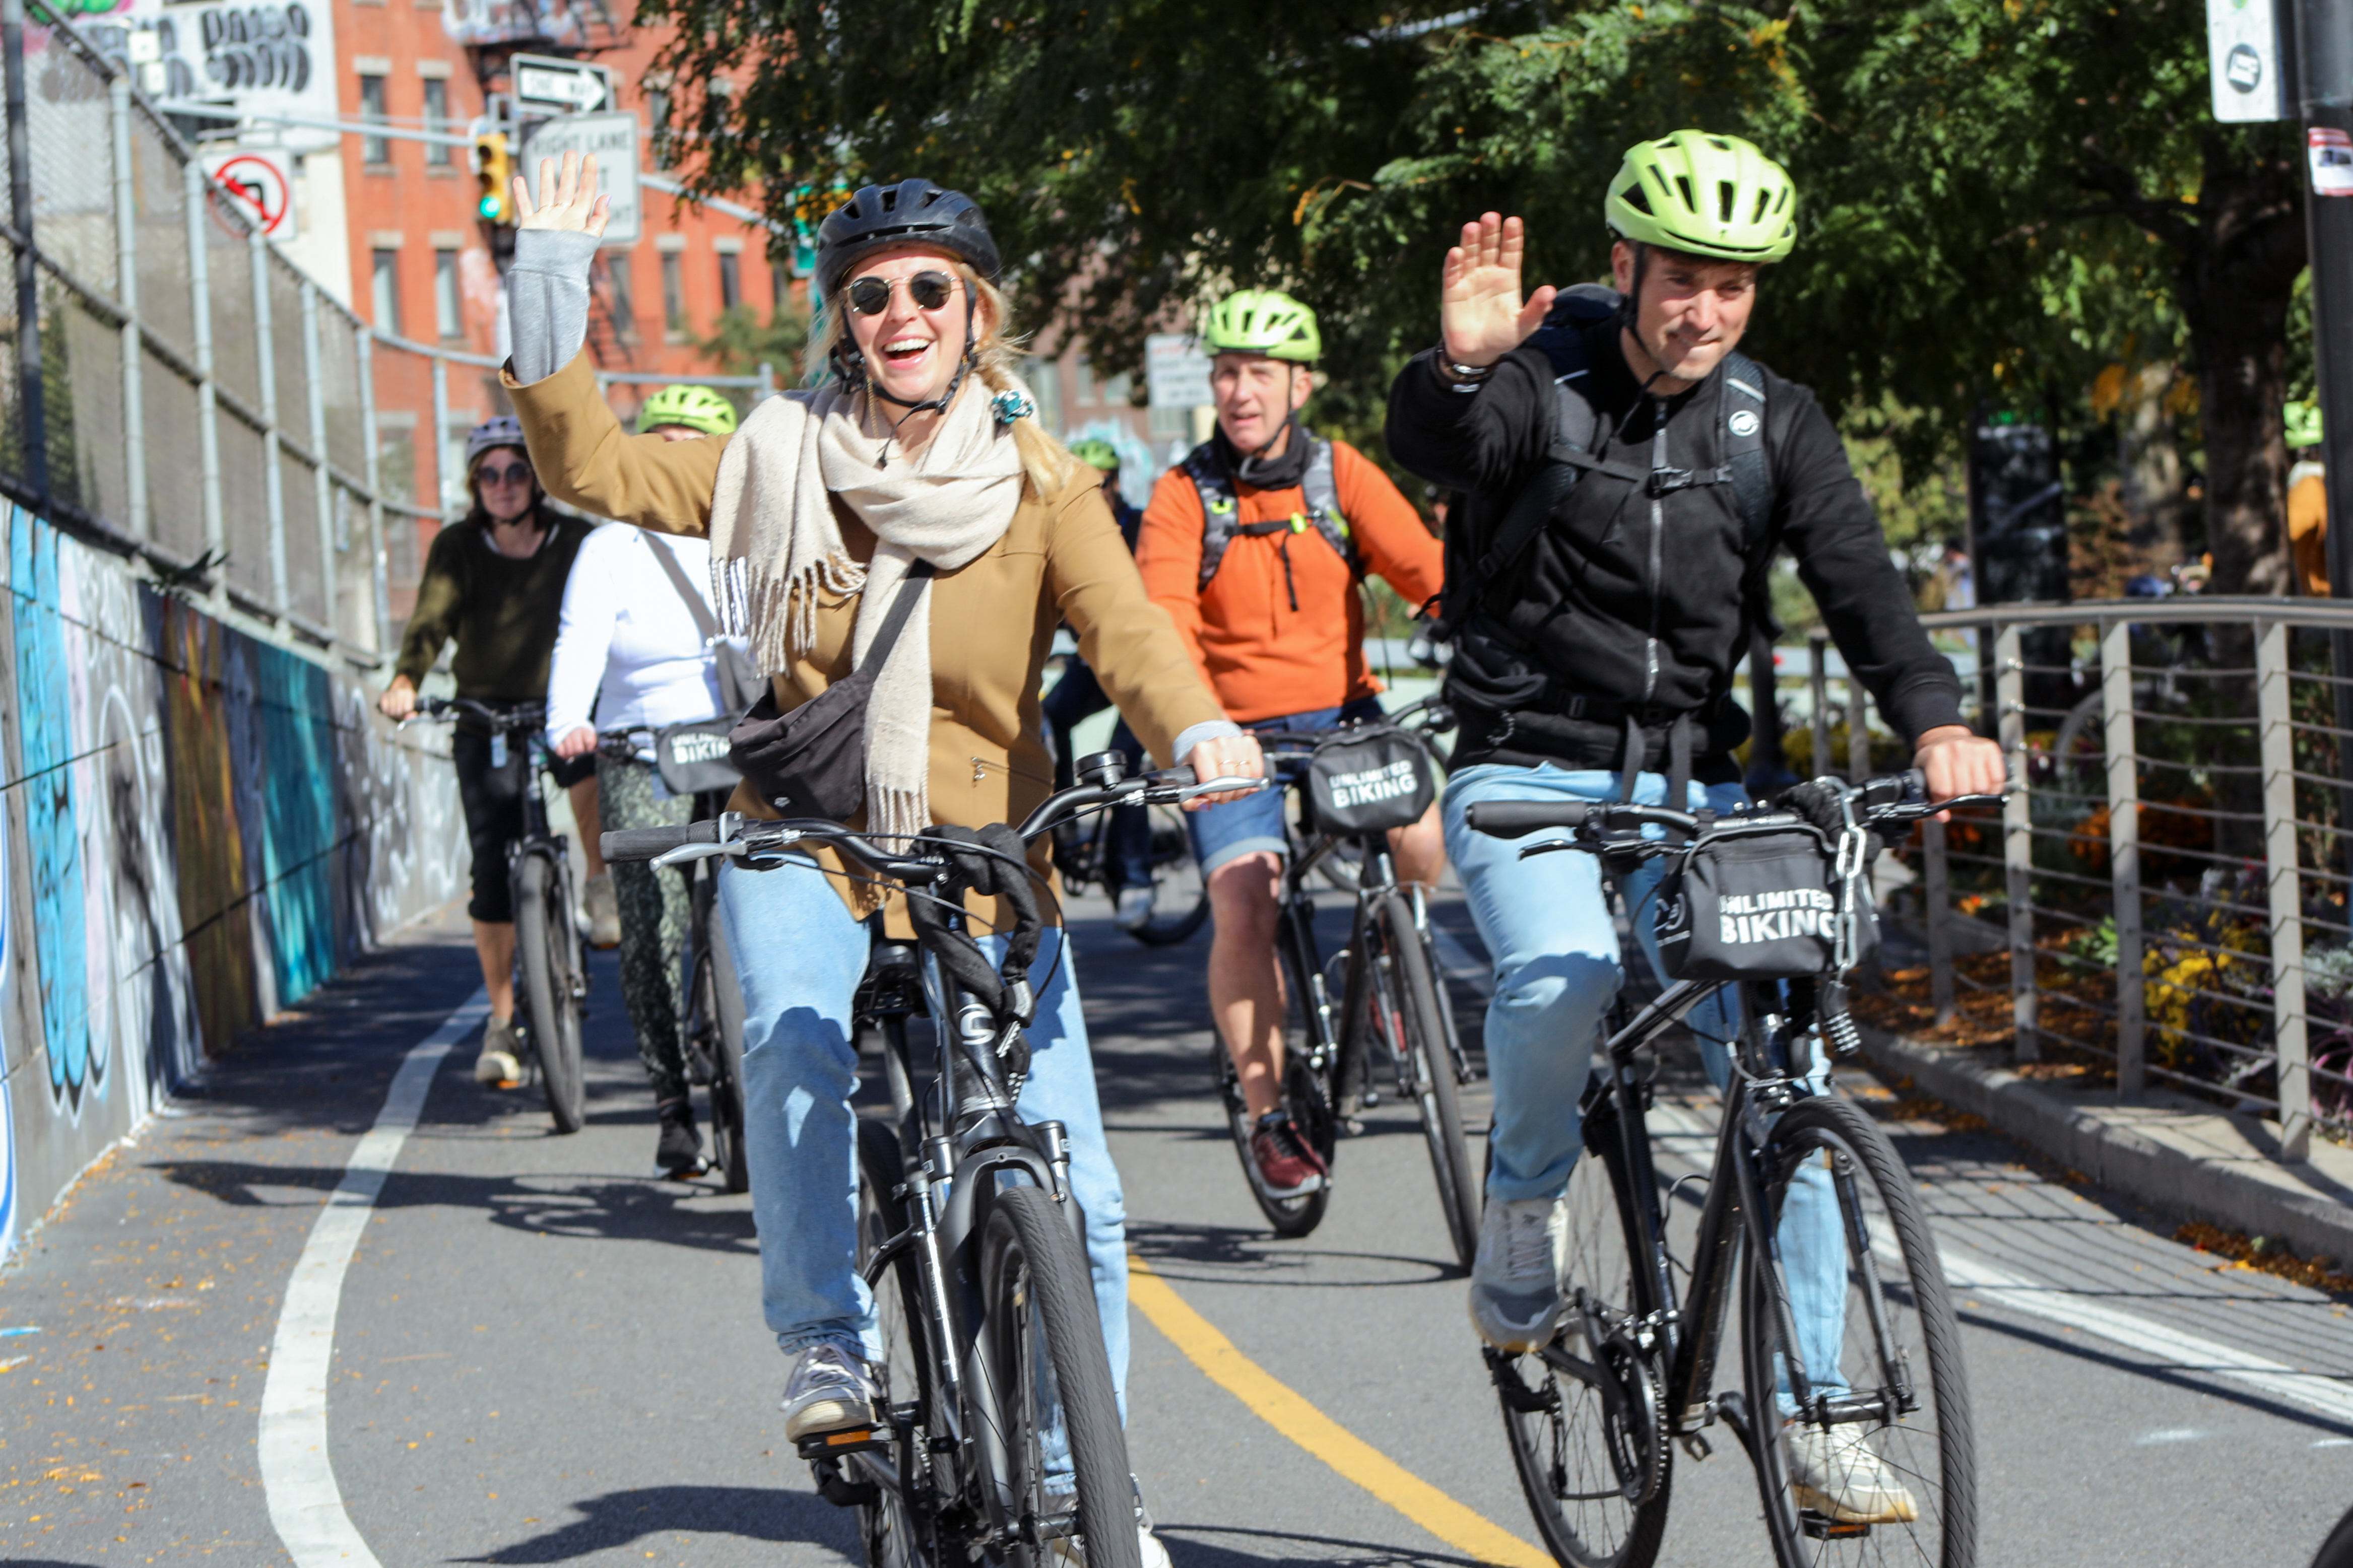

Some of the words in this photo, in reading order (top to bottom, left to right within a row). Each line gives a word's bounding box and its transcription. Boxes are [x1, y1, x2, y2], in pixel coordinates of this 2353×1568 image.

[586, 129, 629, 152] LANE
[674, 740, 731, 765] BIKIN
[1328, 759, 1413, 790] UNLIMITED
[1332, 773, 1418, 809] BIKING
[1718, 889, 1835, 915] UNLIMITED
[1719, 910, 1836, 944] BIKING
